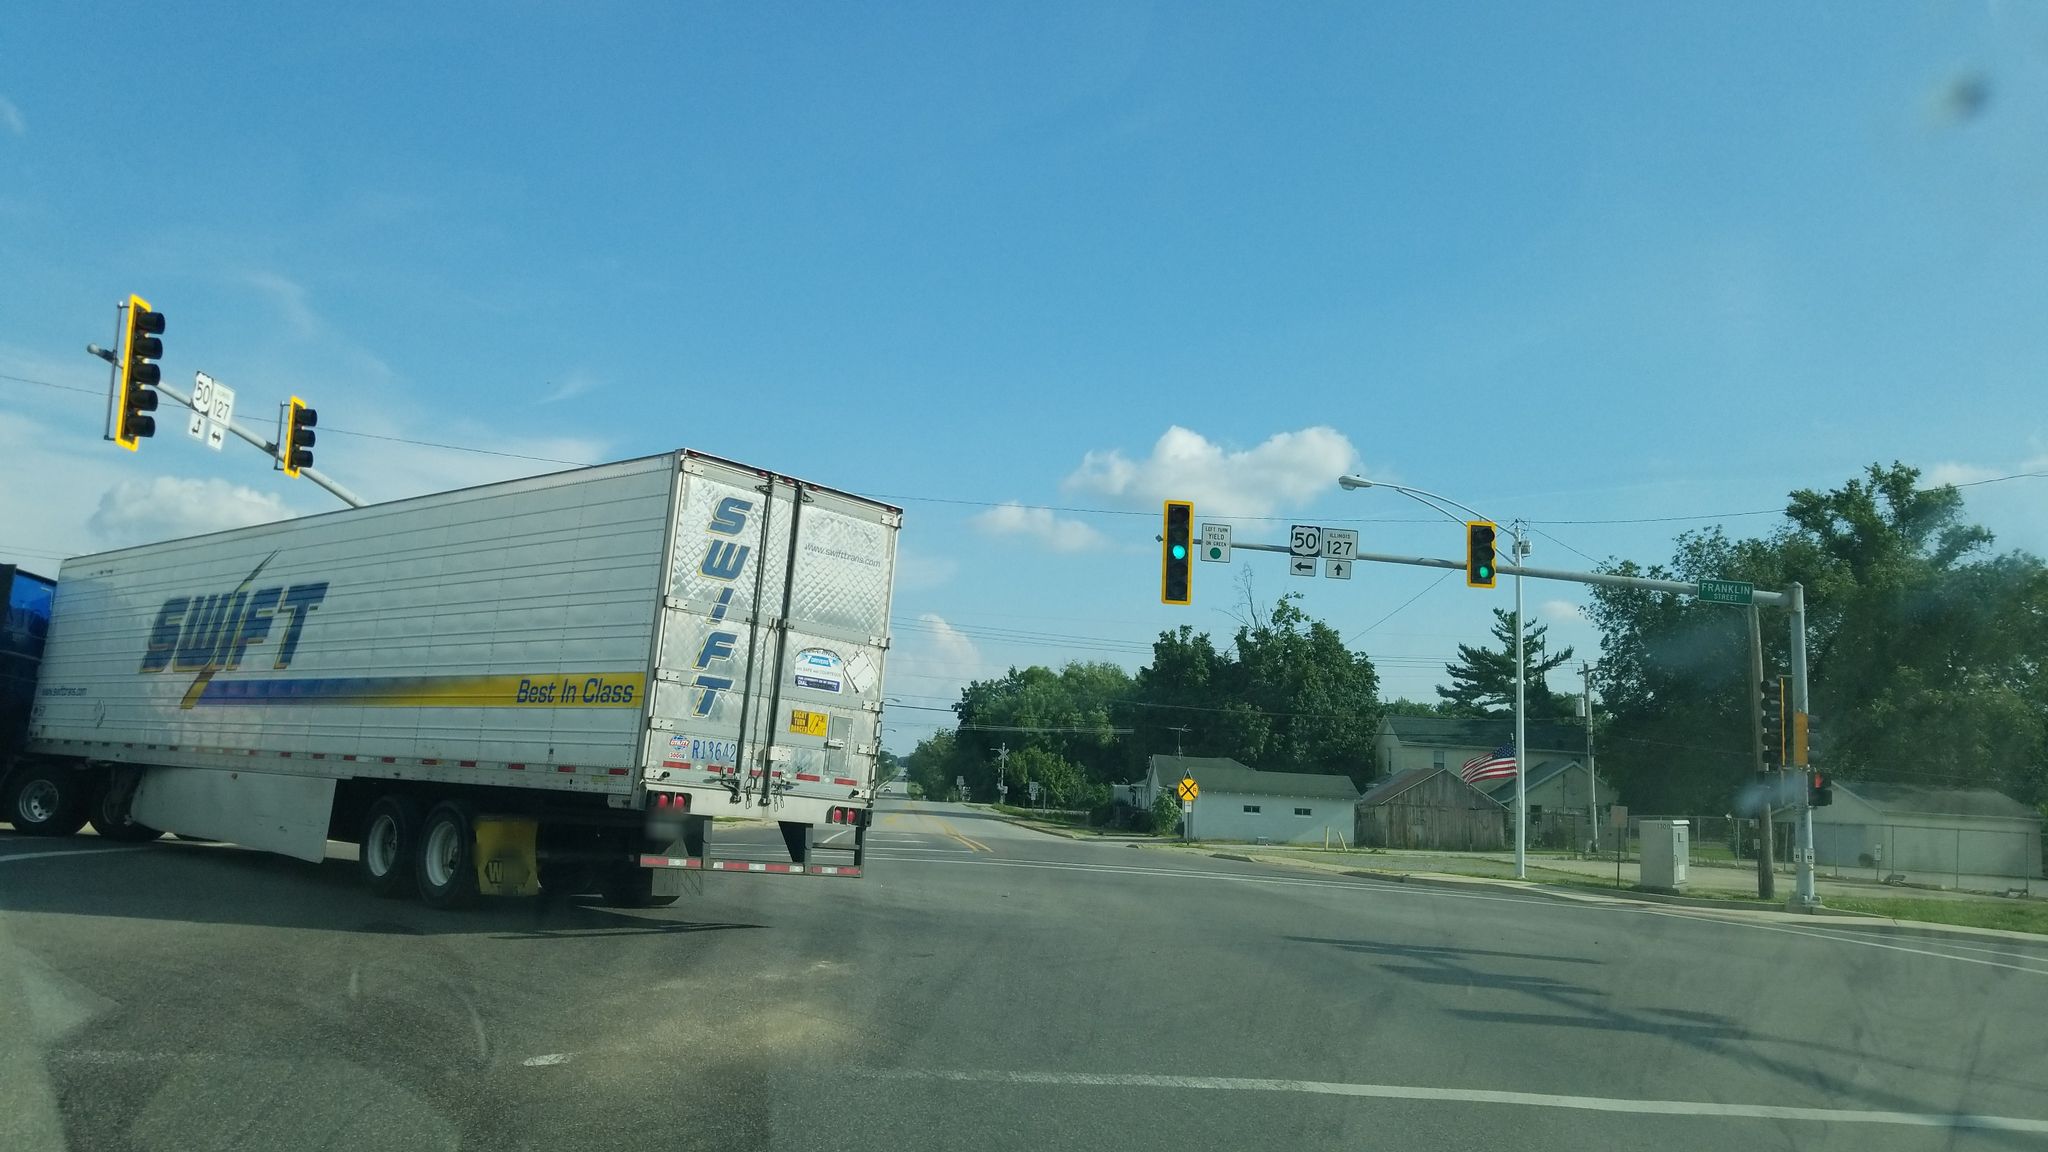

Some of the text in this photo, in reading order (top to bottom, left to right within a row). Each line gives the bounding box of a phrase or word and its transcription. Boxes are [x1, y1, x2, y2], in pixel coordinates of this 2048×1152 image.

[194, 380, 210, 405] 50
[213, 399, 230, 420] 127
[1208, 533, 1225, 541] YIELD
[1294, 532, 1317, 550] 50
[804, 543, 881, 568] www.swifttrans.com
[1326, 540, 1353, 556] 127
[1701, 582, 1750, 596] FRANKLIN
[1713, 593, 1738, 601] STREET
[691, 497, 754, 718] SWIFT
[139, 581, 330, 673] SWIFT
[516, 677, 635, 704] Best In Class
